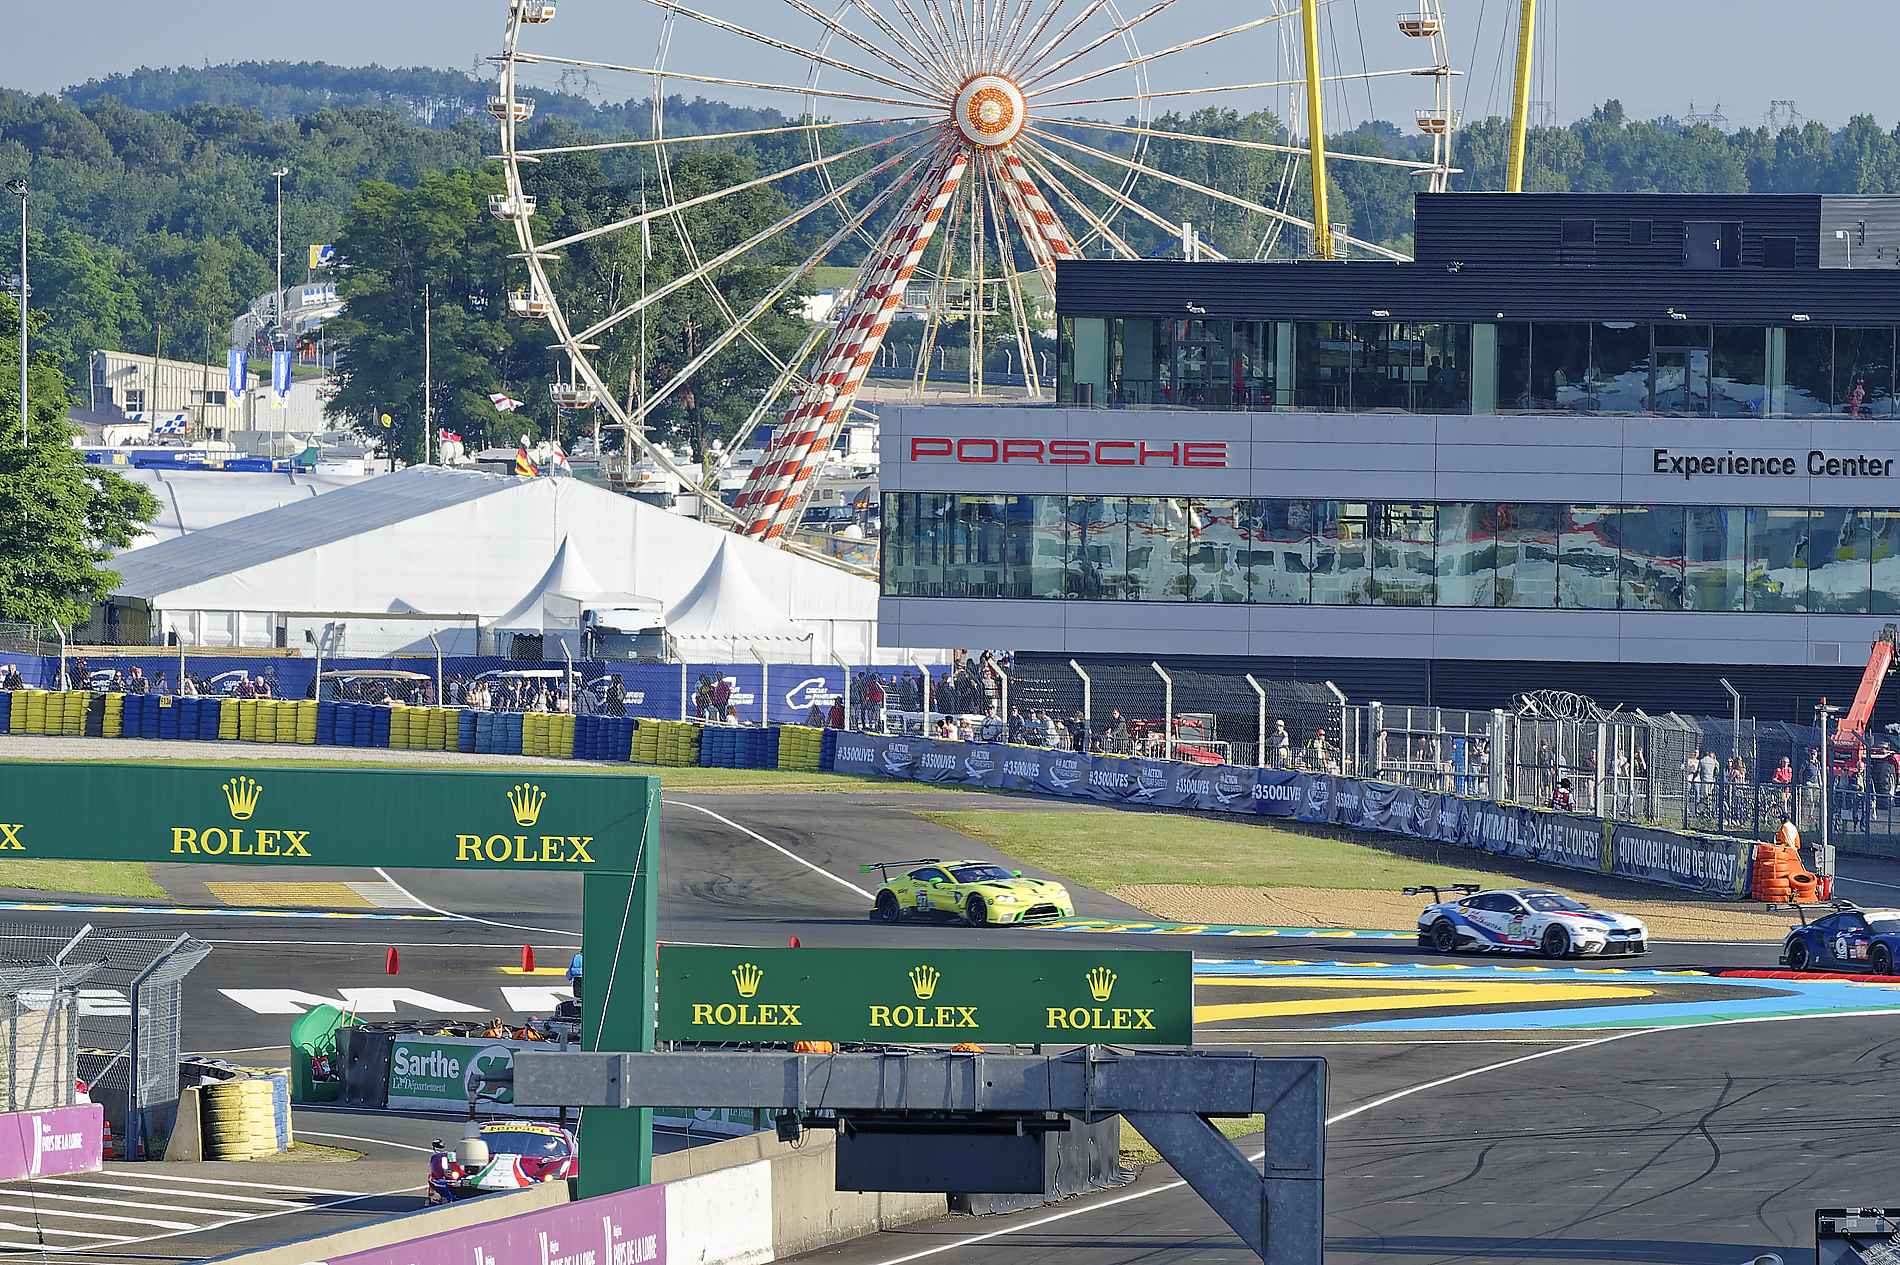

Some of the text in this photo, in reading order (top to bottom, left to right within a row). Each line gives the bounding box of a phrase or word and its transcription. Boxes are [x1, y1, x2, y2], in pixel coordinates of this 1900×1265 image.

[911, 438, 1228, 467] PORSCHE
[1654, 449, 1894, 480] Experience Center
[170, 827, 311, 856] ROLEX
[455, 834, 596, 862] ROLEX
[1620, 837, 1670, 870] AUTOMOBILE
[1670, 845, 1691, 875] CLUB
[691, 1003, 802, 1026] ROLEX
[869, 1005, 979, 1028] ROLEX
[1046, 1007, 1156, 1030] ROLEX
[393, 1047, 460, 1079] Sarthe
[613, 1233, 657, 1265] PAYS DE LA LOIRE
